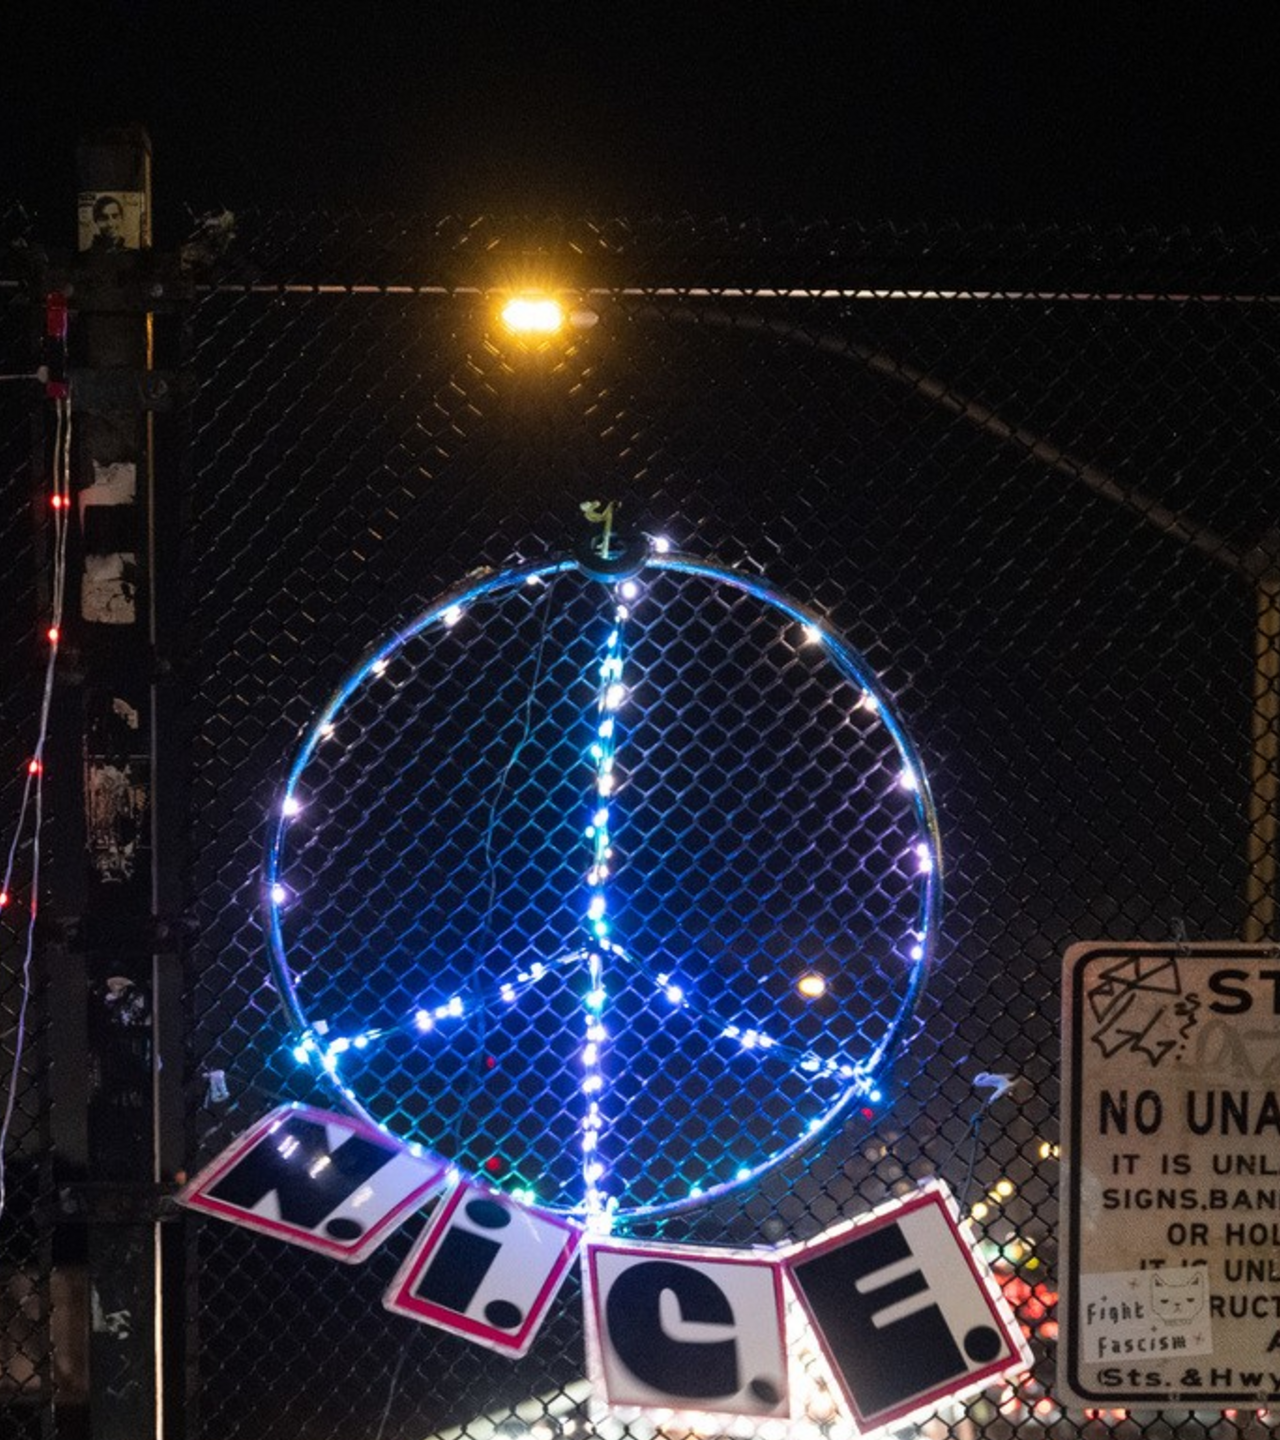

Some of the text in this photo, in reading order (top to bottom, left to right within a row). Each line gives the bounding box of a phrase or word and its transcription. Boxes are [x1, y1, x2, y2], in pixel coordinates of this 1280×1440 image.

[1099, 1090, 1162, 1134] NO
[1113, 1155, 1139, 1175] IT
[1162, 1155, 1191, 1175] IS
[1168, 1224, 1207, 1245] OR
